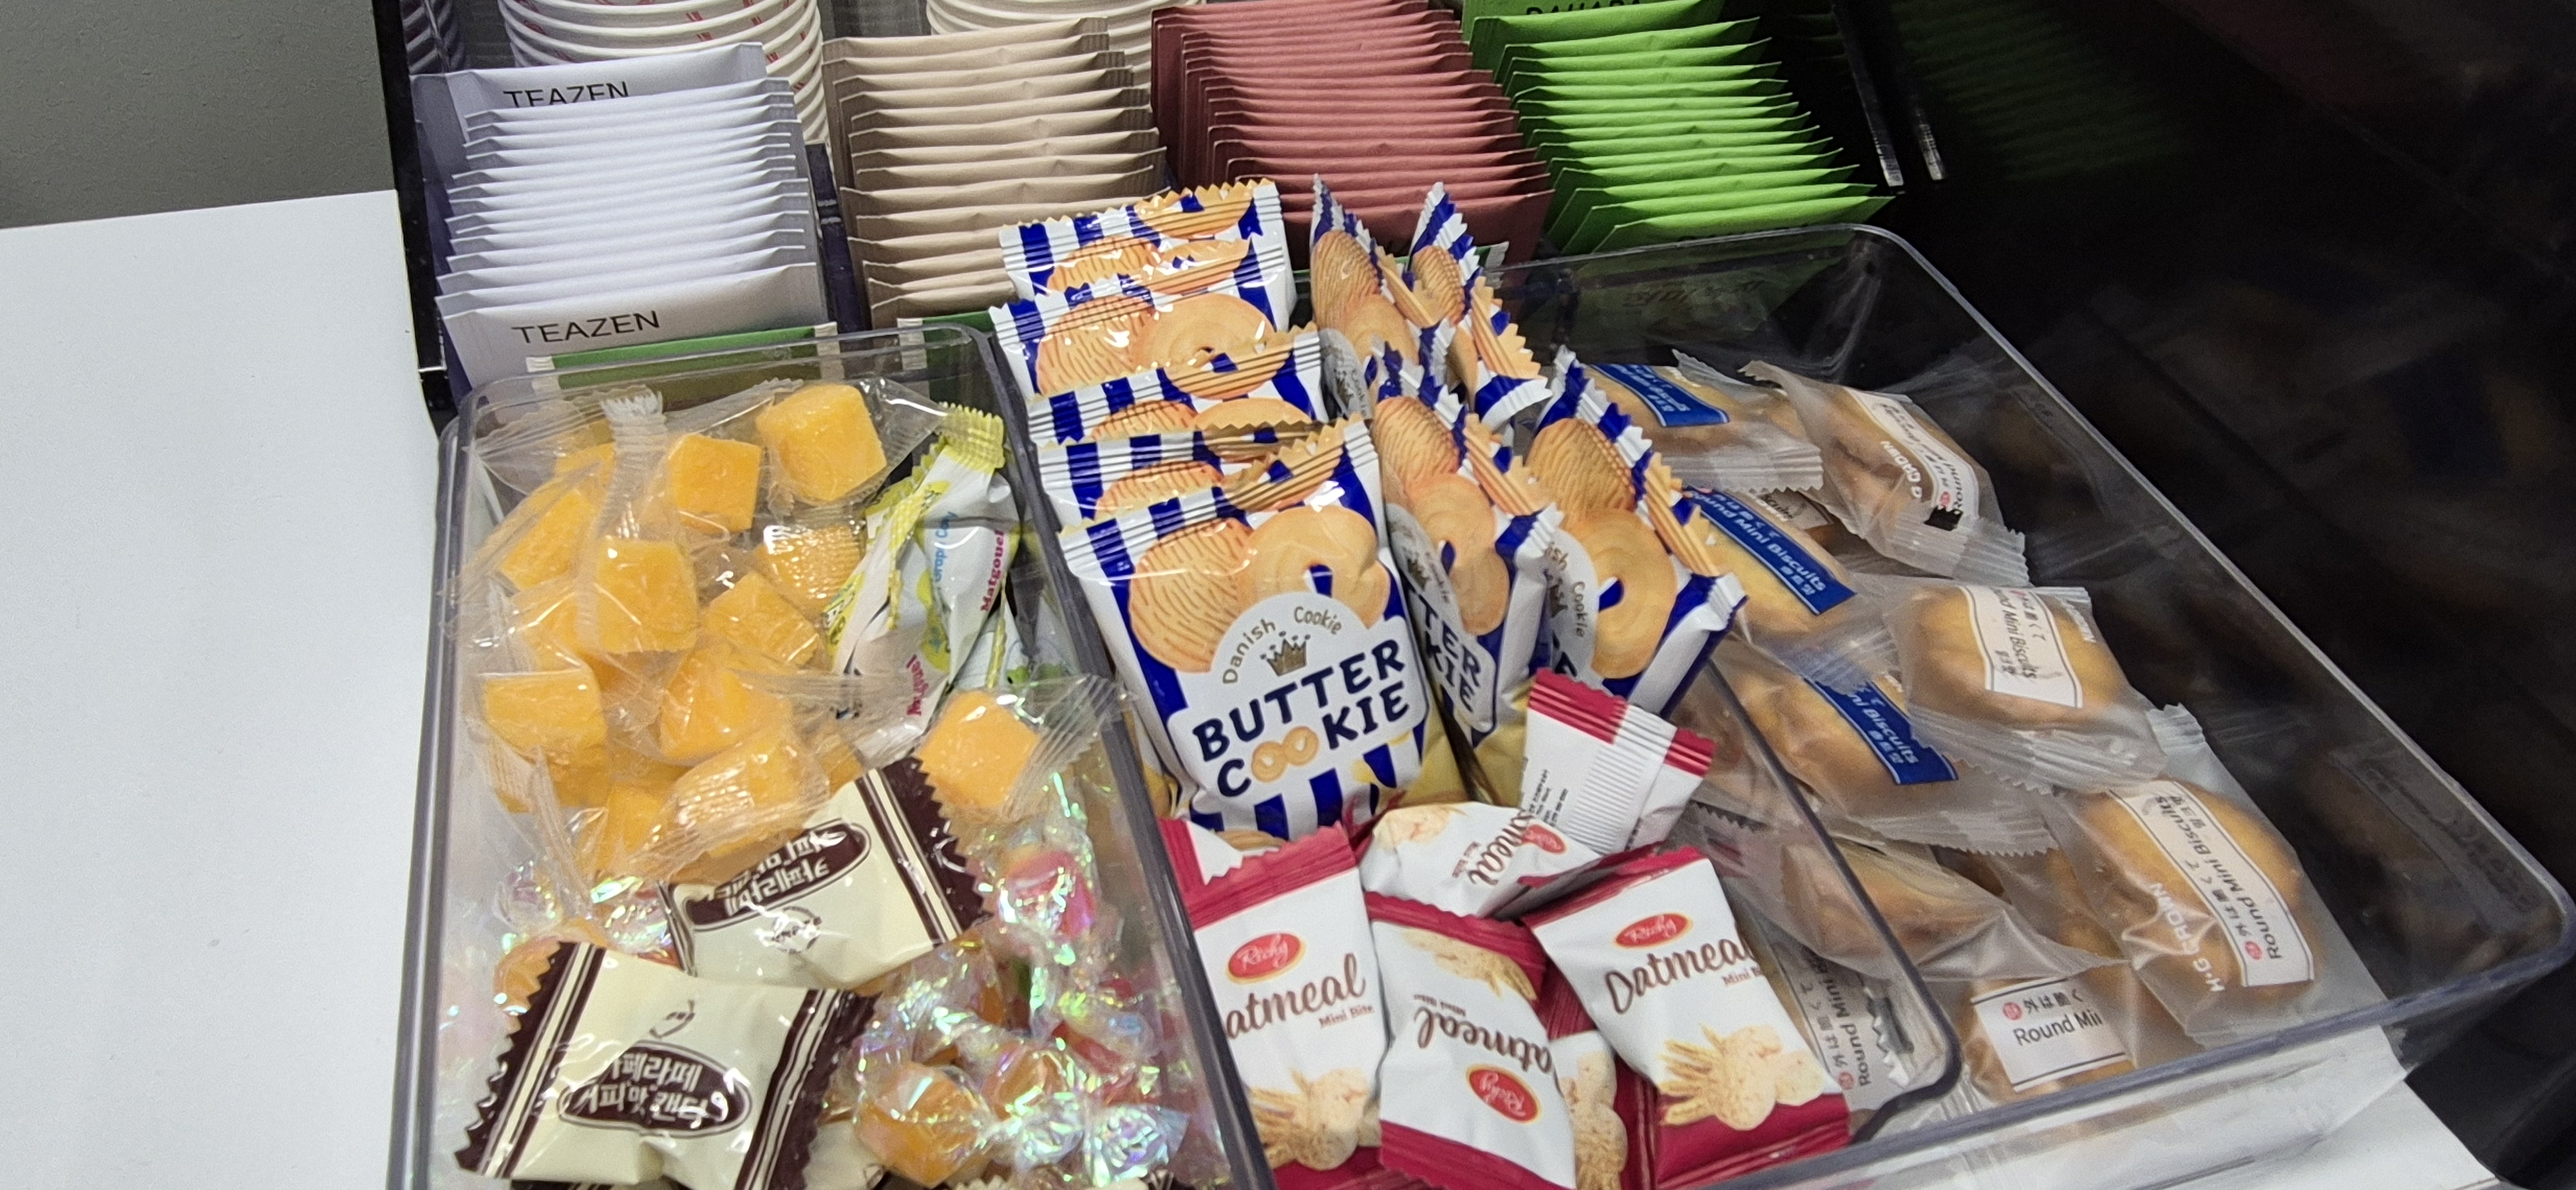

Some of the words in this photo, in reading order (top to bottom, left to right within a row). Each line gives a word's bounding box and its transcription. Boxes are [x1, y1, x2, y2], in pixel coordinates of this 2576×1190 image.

[511, 310, 661, 345] TEAZEN
[1734, 518, 1770, 544] Mini
[1767, 543, 1826, 592] Biscuits
[1571, 581, 1586, 639] Cookie
[1222, 618, 1277, 685] Danish
[1293, 605, 1343, 636] Cookie
[1192, 639, 1406, 762] BUTTER
[1862, 708, 1920, 764] Biscuits
[2155, 796, 2211, 855] Biscuits
[2204, 858, 2244, 893] Mini
[2237, 896, 2282, 959] Round
[1226, 952, 1367, 1040] atmeal
[1820, 978, 1851, 1018] Mini
[1414, 1006, 1553, 1073] atmeal
[1839, 1023, 1872, 1087] Round
[2012, 1014, 2076, 1046] Round
